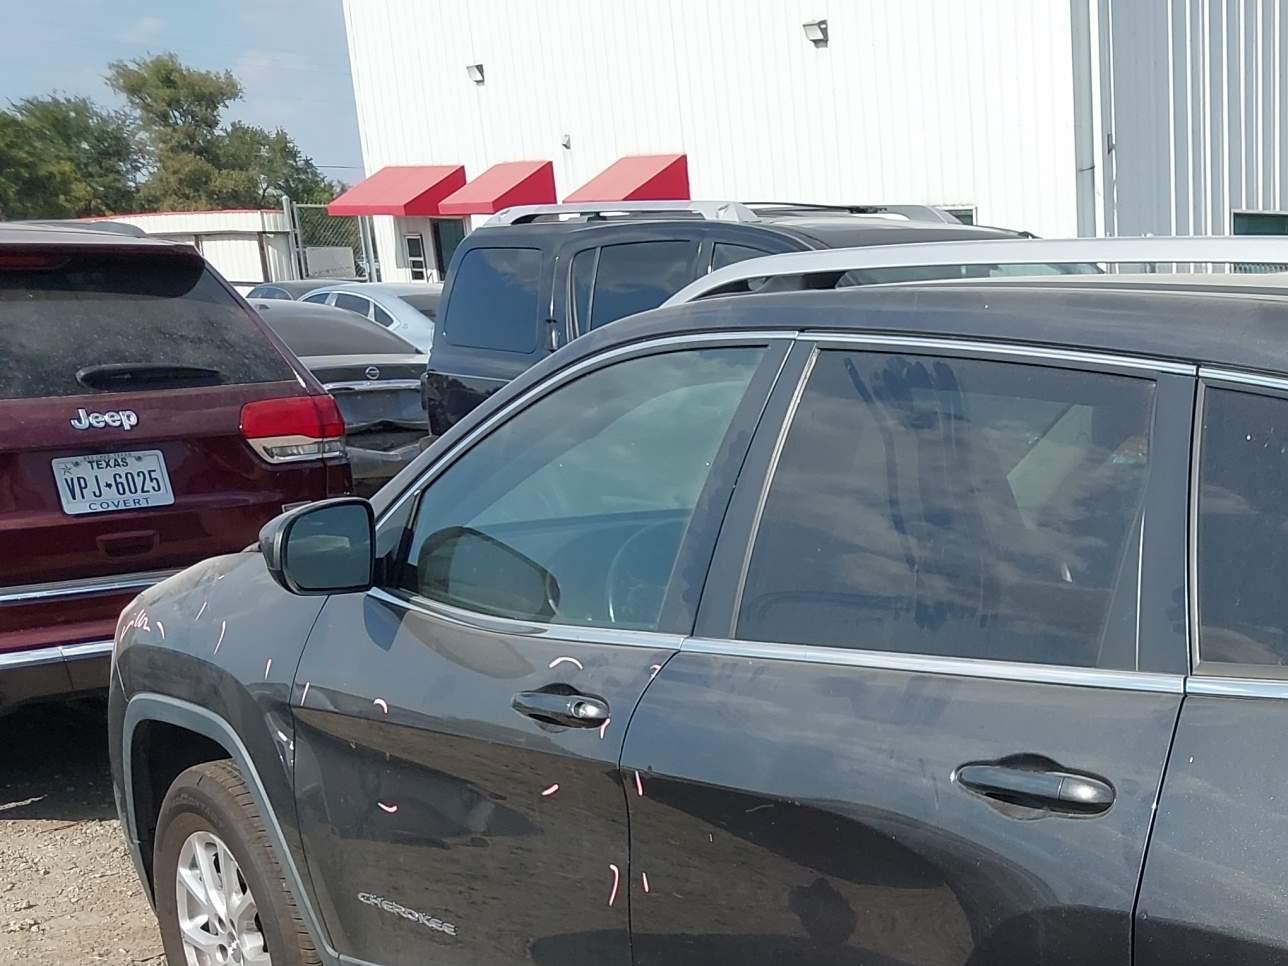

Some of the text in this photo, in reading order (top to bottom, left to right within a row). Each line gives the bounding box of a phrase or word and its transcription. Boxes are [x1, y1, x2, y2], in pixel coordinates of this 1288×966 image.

[70, 408, 138, 431] Jeep
[87, 457, 129, 471] TEXAS
[88, 497, 151, 511] COVERT
[357, 892, 457, 936] CHEROKEE
